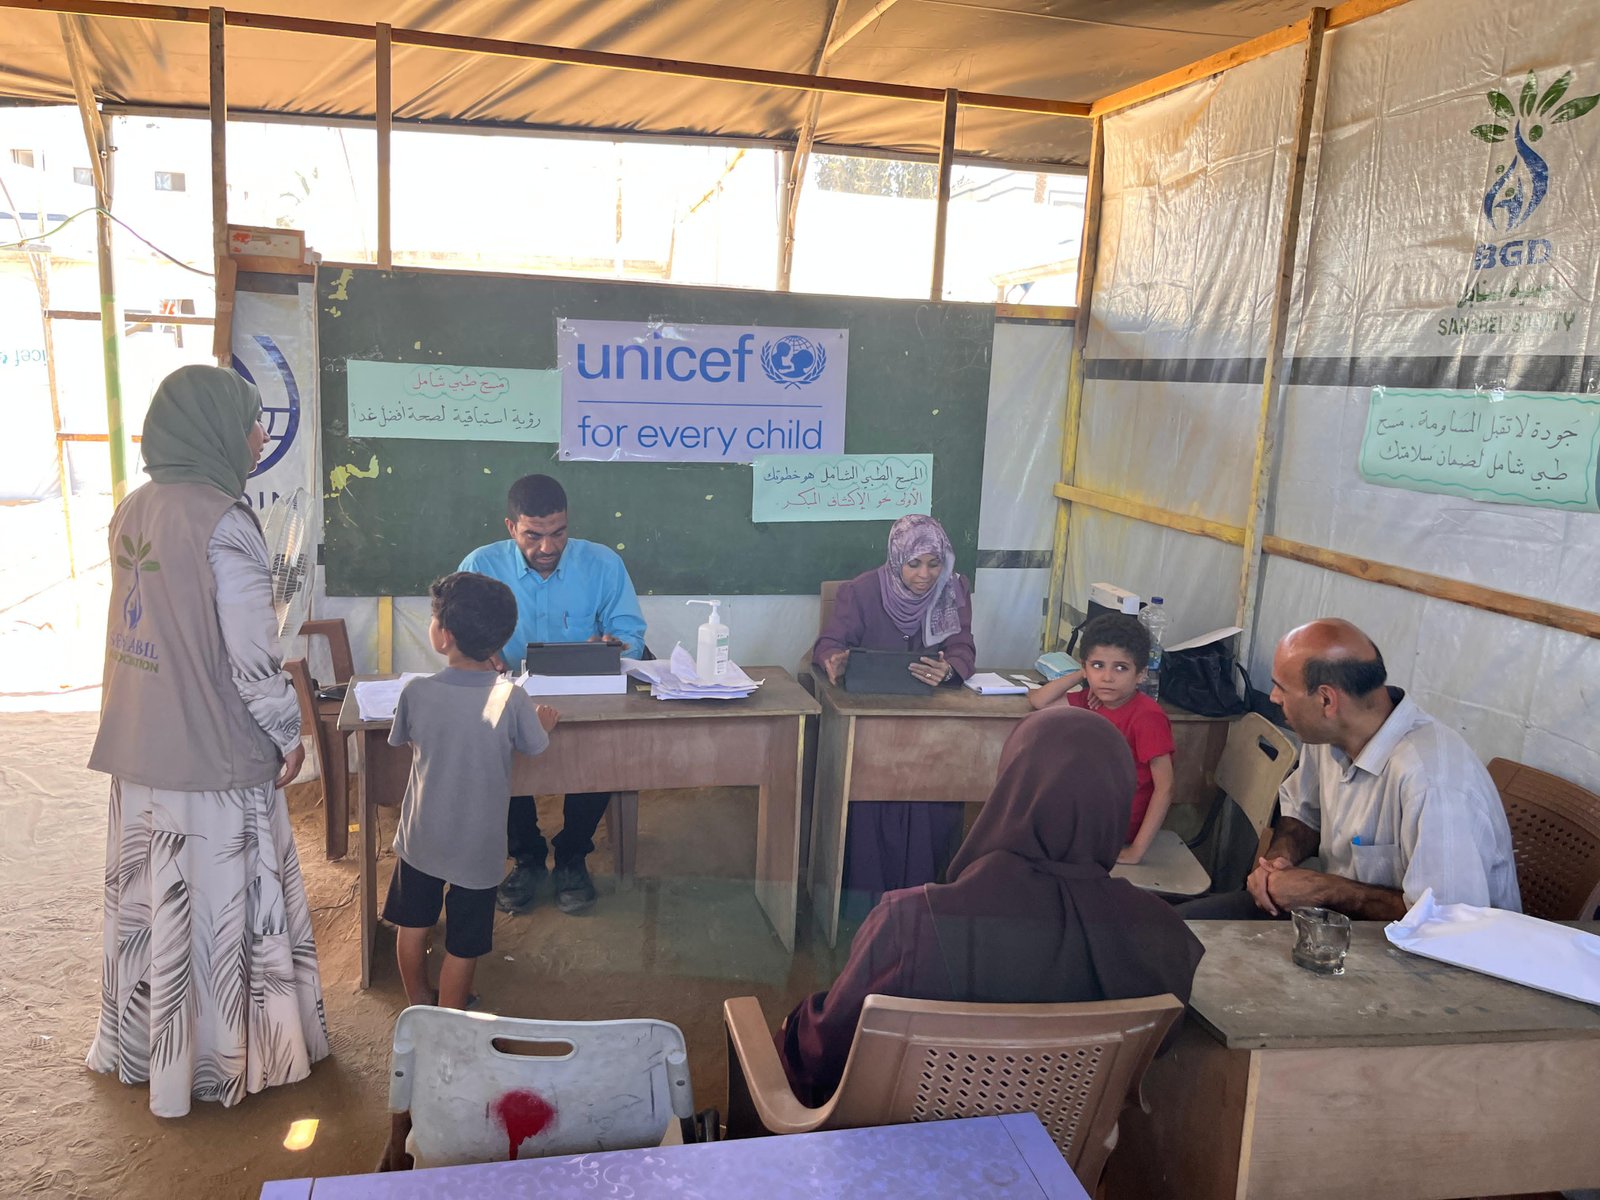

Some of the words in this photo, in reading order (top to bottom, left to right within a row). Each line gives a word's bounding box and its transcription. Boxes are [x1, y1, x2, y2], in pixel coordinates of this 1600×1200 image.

[1474, 239, 1551, 270] BGD
[577, 331, 755, 383] unicef
[412, 371, 446, 390] شامل
[448, 373, 477, 391] طبي
[408, 404, 446, 422] لصحة
[453, 406, 508, 427] استباقية
[511, 408, 542, 430] رؤية
[577, 415, 629, 448] for
[637, 424, 737, 456] every
[746, 419, 823, 450] child
[1436, 445, 1485, 469] لضمان
[1486, 450, 1525, 479] شامل
[763, 466, 801, 484] خطوتك
[800, 471, 815, 484] هو
[820, 465, 859, 484] الشامل
[860, 465, 893, 489] الطبي
[1530, 457, 1568, 490] طبي
[876, 490, 892, 508] نحو
